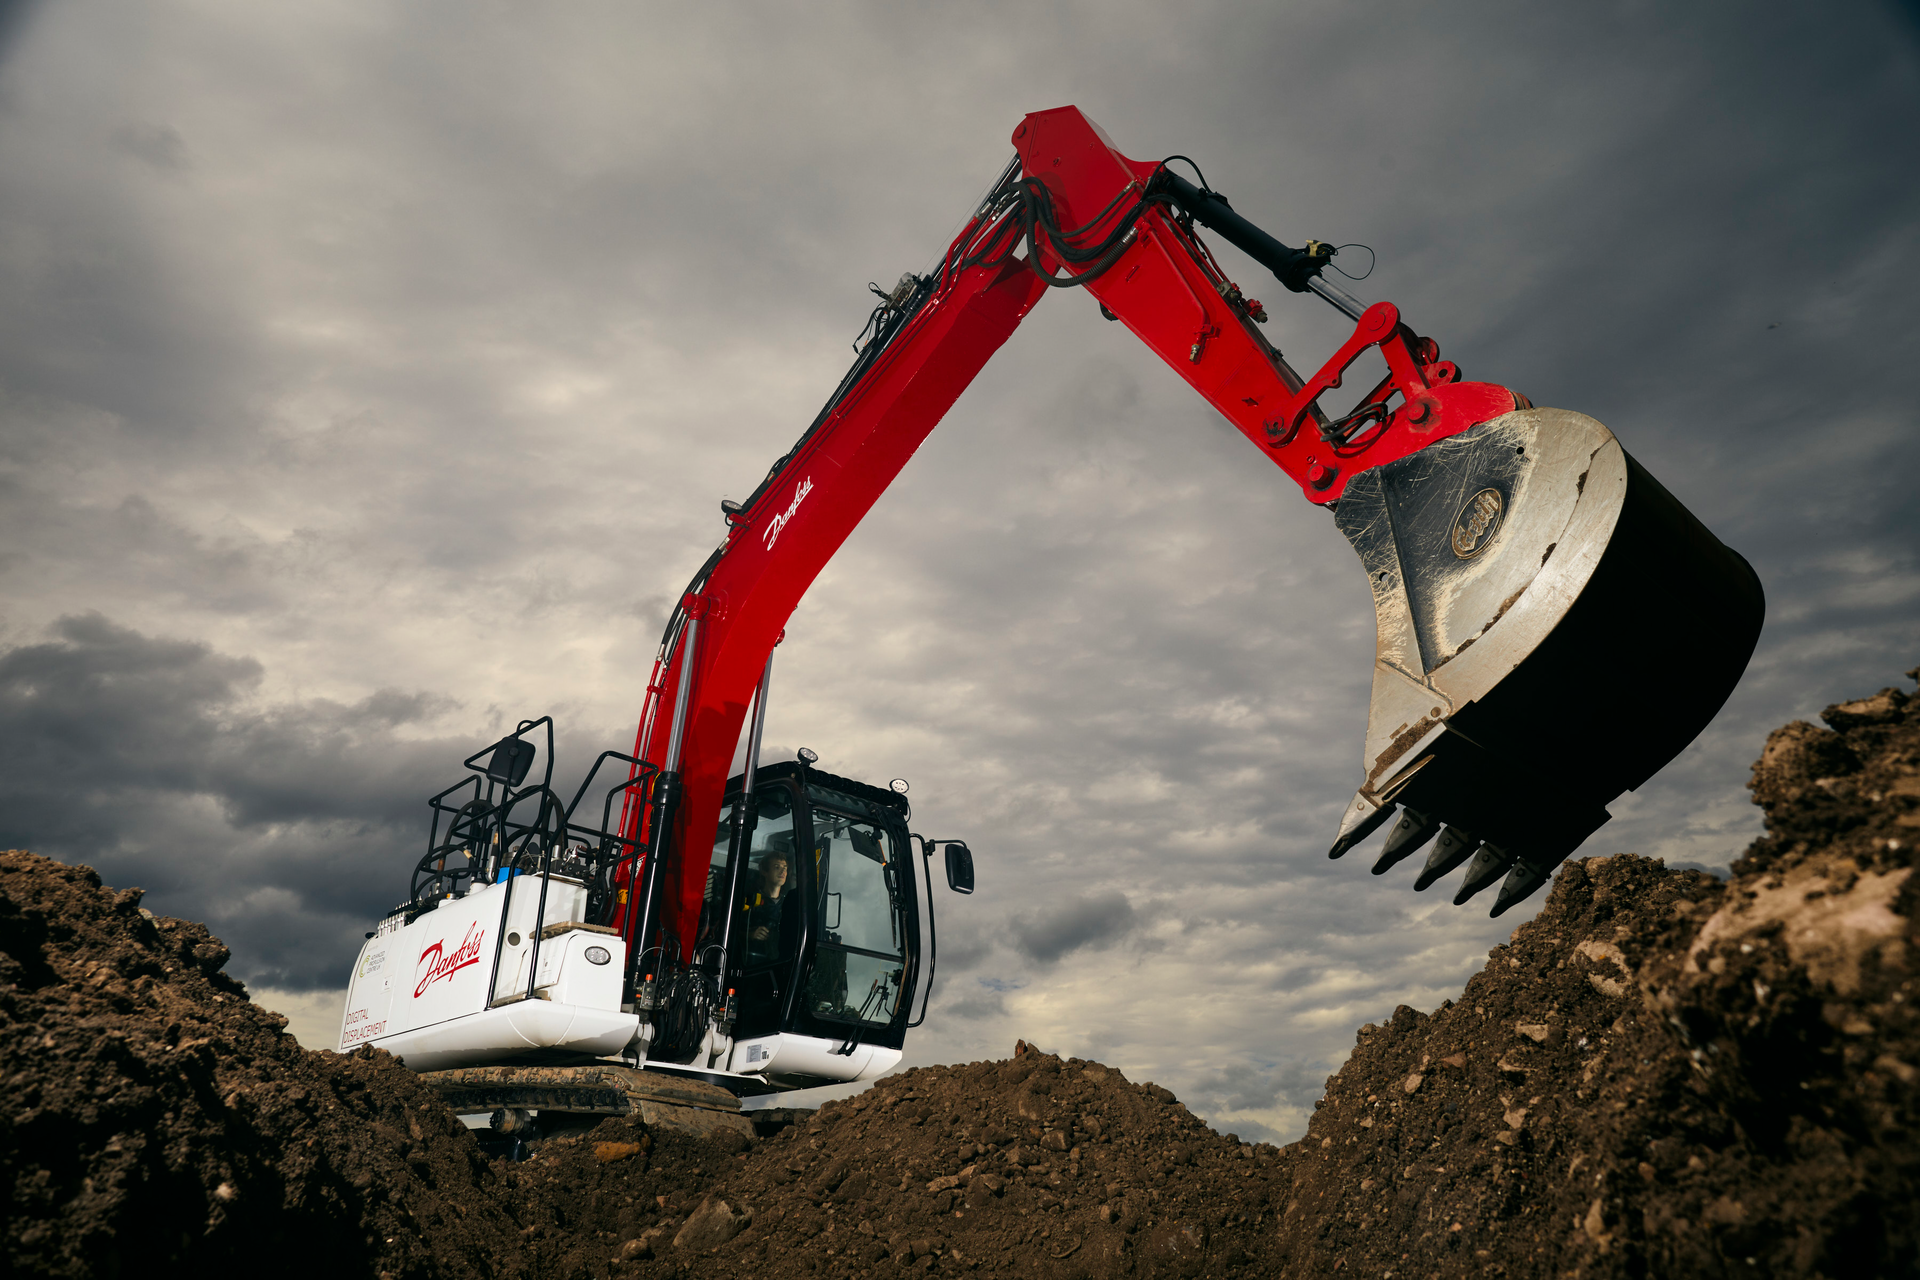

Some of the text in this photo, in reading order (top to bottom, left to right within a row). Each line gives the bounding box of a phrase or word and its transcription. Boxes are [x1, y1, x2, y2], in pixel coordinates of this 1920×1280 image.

[763, 475, 814, 551] Danfoss
[413, 920, 485, 999] Danfoss
[343, 1020, 387, 1044] DISPLACEMENT
[346, 1008, 369, 1025] DIGITAL
